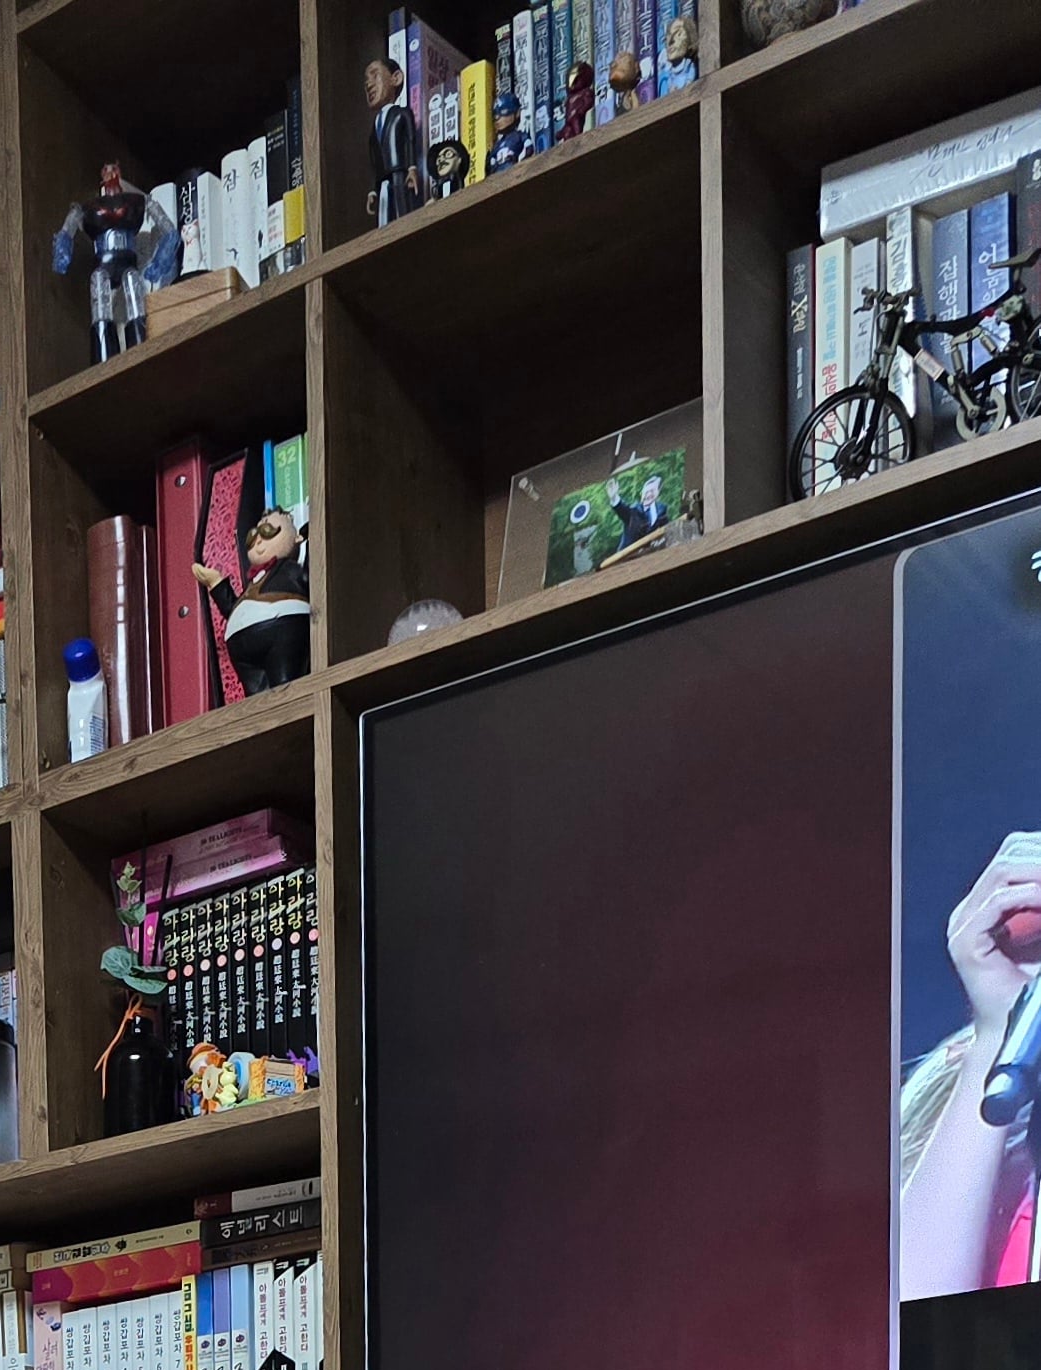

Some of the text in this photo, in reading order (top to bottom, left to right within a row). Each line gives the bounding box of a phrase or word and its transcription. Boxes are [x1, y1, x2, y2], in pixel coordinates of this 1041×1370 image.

[66, 1327, 74, 1370] 쌍갑포차
[83, 1323, 91, 1367] 쌍갑포차
[103, 1320, 111, 1364] 쌍갑포차
[120, 1317, 128, 1361] 쌍갑포차
[136, 1317, 144, 1361] 쌍갑포차
[155, 1313, 163, 1357] 쌍갑포차
[173, 1309, 182, 1353] 쌍갑포차
